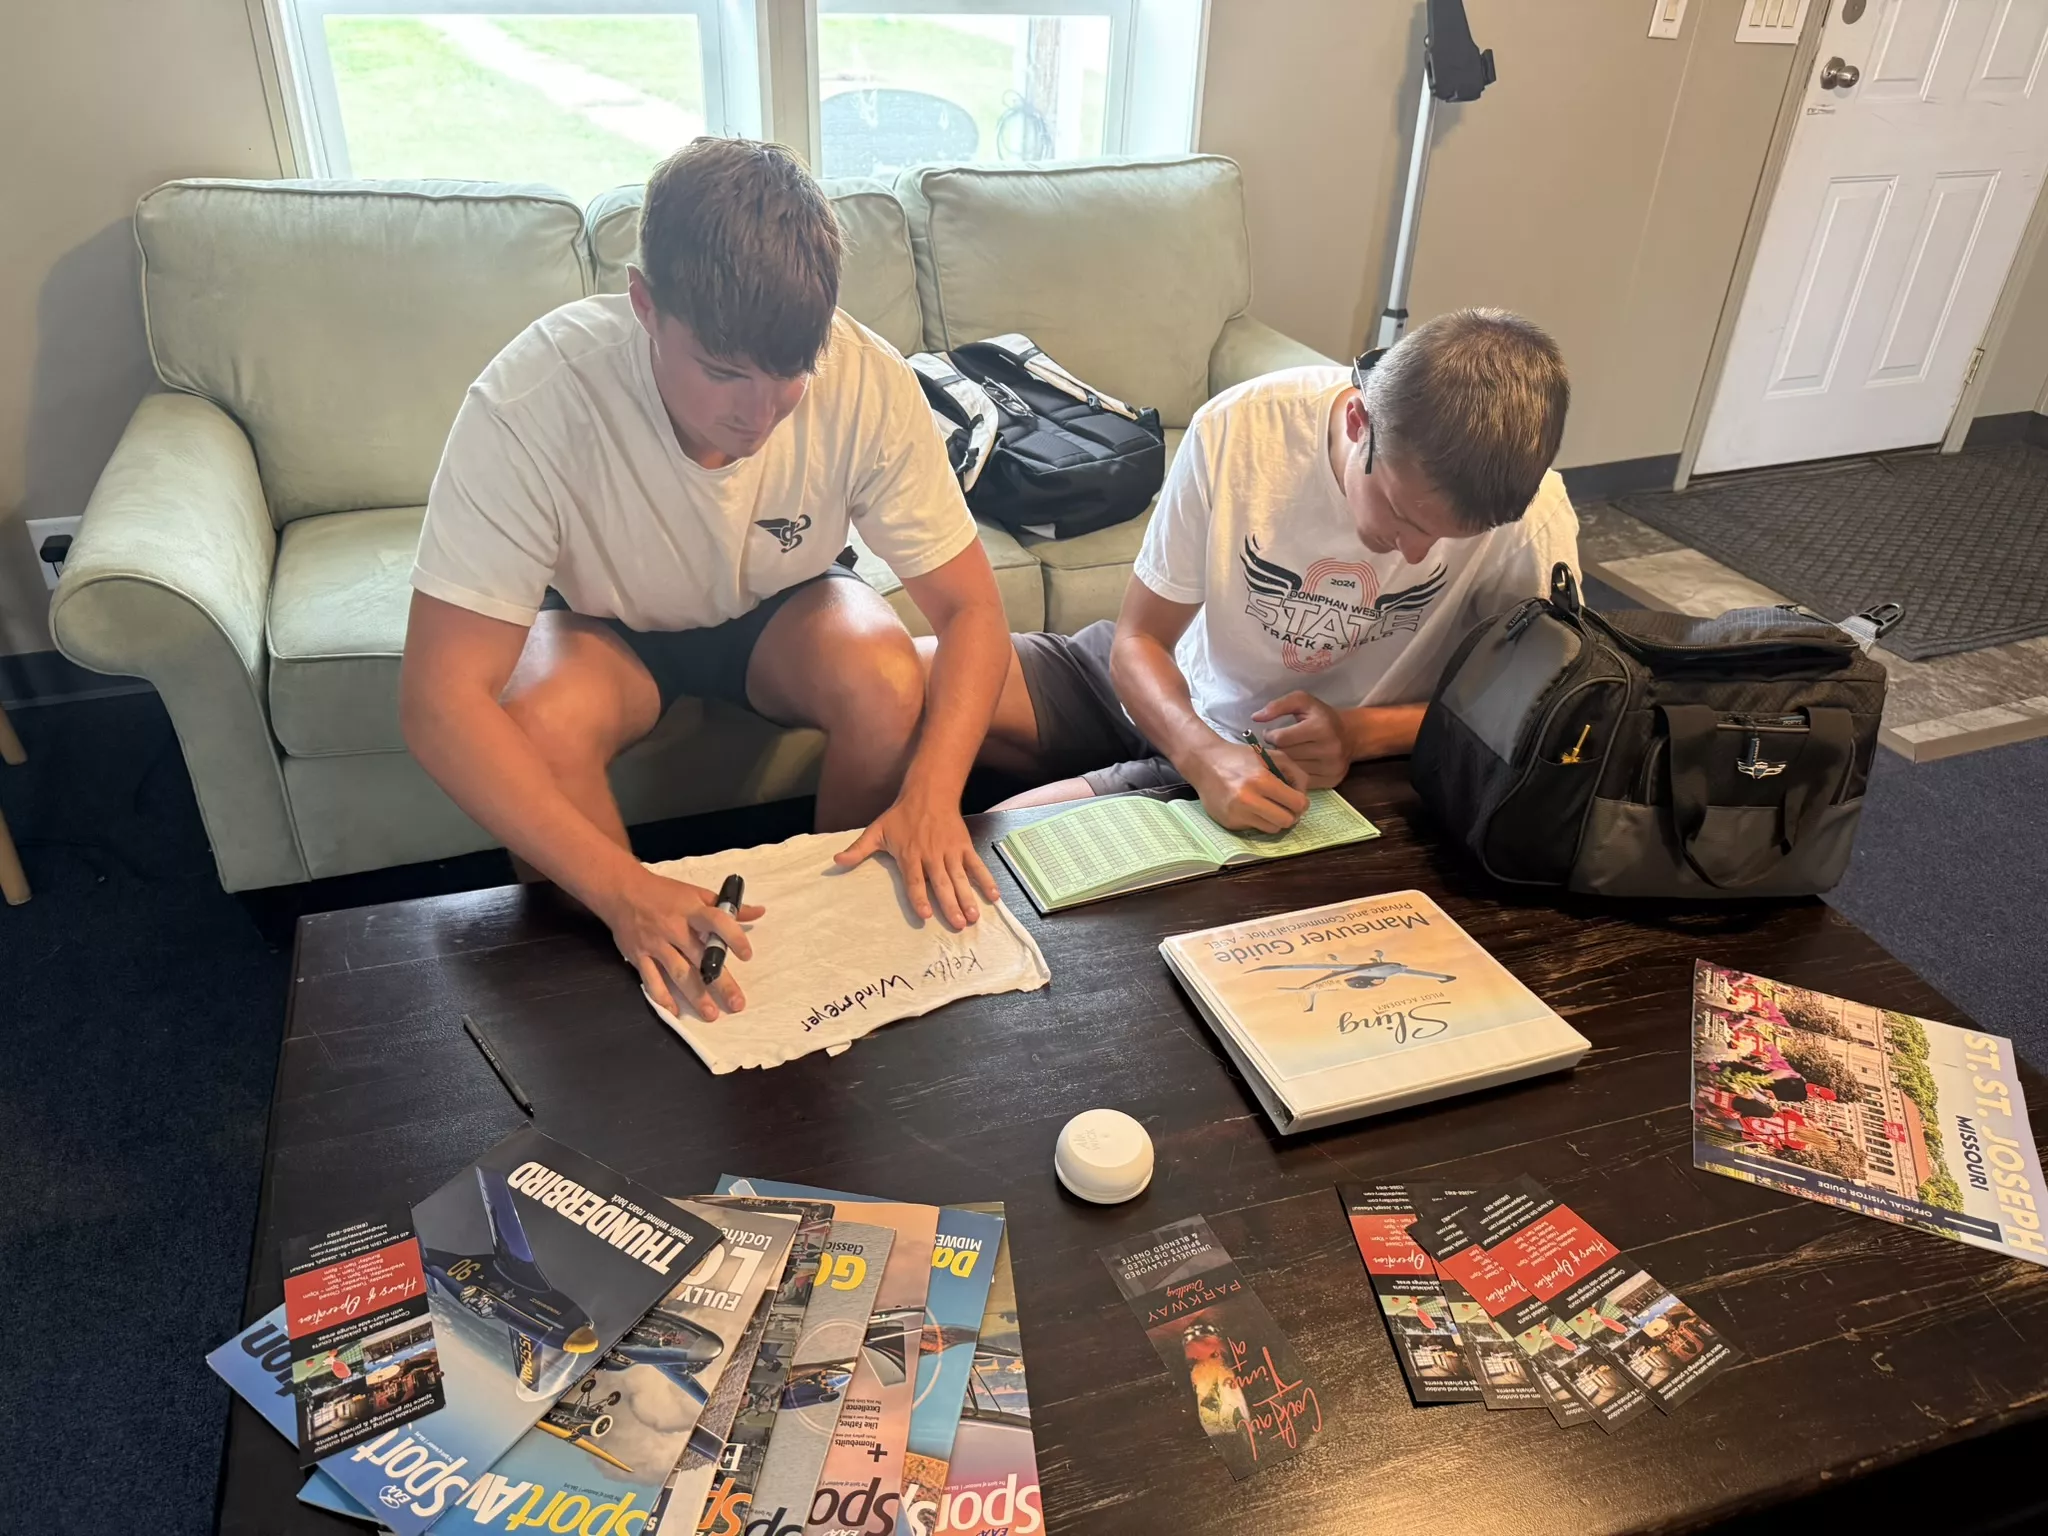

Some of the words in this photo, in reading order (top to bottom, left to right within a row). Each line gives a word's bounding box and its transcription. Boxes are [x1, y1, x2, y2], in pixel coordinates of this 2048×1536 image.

[1331, 579, 1355, 589] 2024
[1290, 590, 1347, 611] DONIPHAN
[1352, 605, 1383, 618] WEST
[1245, 590, 1423, 644] STATE
[1262, 625, 1315, 649] TRACK
[1347, 910, 1369, 922] and
[1372, 901, 1412, 917] Private
[1248, 924, 1276, 942] Pilot
[1279, 914, 1345, 937] Commercial
[1300, 912, 1430, 947] Maneuver
[1204, 937, 1236, 950] ASEL
[1214, 940, 1293, 966] Guide
[802, 974, 913, 1032] Windmeyer
[1376, 996, 1417, 1012] ACADEMY
[1421, 991, 1444, 1002] PILOT
[1336, 1001, 1451, 1045] Sling
[1963, 1032, 2001, 1071] ST.
[1971, 1082, 2012, 1118] ST.
[1955, 1115, 1990, 1191] MISSOURI
[1818, 1181, 1847, 1193] GUIDE
[1982, 1125, 2047, 1256] JOSEPH
[611, 1194, 627, 1208] back
[1850, 1189, 1887, 1205] VISITOR
[628, 1202, 644, 1217] roars
[1890, 1201, 1932, 1217] OFFICIAL
[507, 1161, 685, 1275] THUNDERBIRD
[645, 1212, 669, 1230] winner
[382, 1234, 399, 1244] North
[670, 1226, 693, 1245] Bendix
[1154, 1235, 1190, 1252] BLENDED
[351, 1244, 369, 1253] Street
[826, 1241, 864, 1255] Classic
[1121, 1248, 1152, 1265] ONSITE
[1171, 1240, 1201, 1257] SPIRITS
[1574, 1237, 1612, 1265] Hours
[315, 1253, 337, 1265] Joseph,
[1125, 1244, 1212, 1280] UNIQUELY-FLAVORED
[1128, 1252, 1169, 1271] DISTILLED
[1372, 1248, 1424, 1269] Operation
[1563, 1249, 1584, 1266] of
[289, 1261, 314, 1273] Missouri
[1523, 1254, 1579, 1295] Operation
[318, 1288, 340, 1301] Closed
[364, 1286, 377, 1304] of
[378, 1275, 417, 1304] Hours
[1167, 1279, 1204, 1297] Distilling
[676, 1286, 741, 1312] FULLY
[1148, 1279, 1241, 1322] PARKWAY
[296, 1290, 361, 1332] Operation
[384, 1309, 409, 1323] Covered
[390, 1307, 403, 1316] with
[357, 1312, 389, 1328] court-side
[368, 1319, 383, 1329] deck
[332, 1326, 361, 1342] pickleball
[336, 1323, 356, 1336] lounge
[311, 1338, 331, 1350] courts
[1227, 1336, 1247, 1371] at
[1223, 1346, 1303, 1407] Time
[402, 1401, 412, 1410] for
[412, 1392, 432, 1405] space
[369, 1405, 402, 1424] gatherings
[395, 1397, 434, 1418] Comfortable
[846, 1404, 881, 1412] Excellence
[338, 1422, 361, 1437] private
[372, 1414, 394, 1428] tasting
[839, 1419, 862, 1429] Father,
[865, 1421, 878, 1429] Like
[1237, 1387, 1322, 1461] Cocktail
[340, 1432, 353, 1442] and
[354, 1424, 371, 1436] room
[313, 1438, 339, 1454] outdoor
[835, 1439, 875, 1448] Homebuilts
[351, 1427, 470, 1518] Sport
[385, 1485, 412, 1504] EAA
